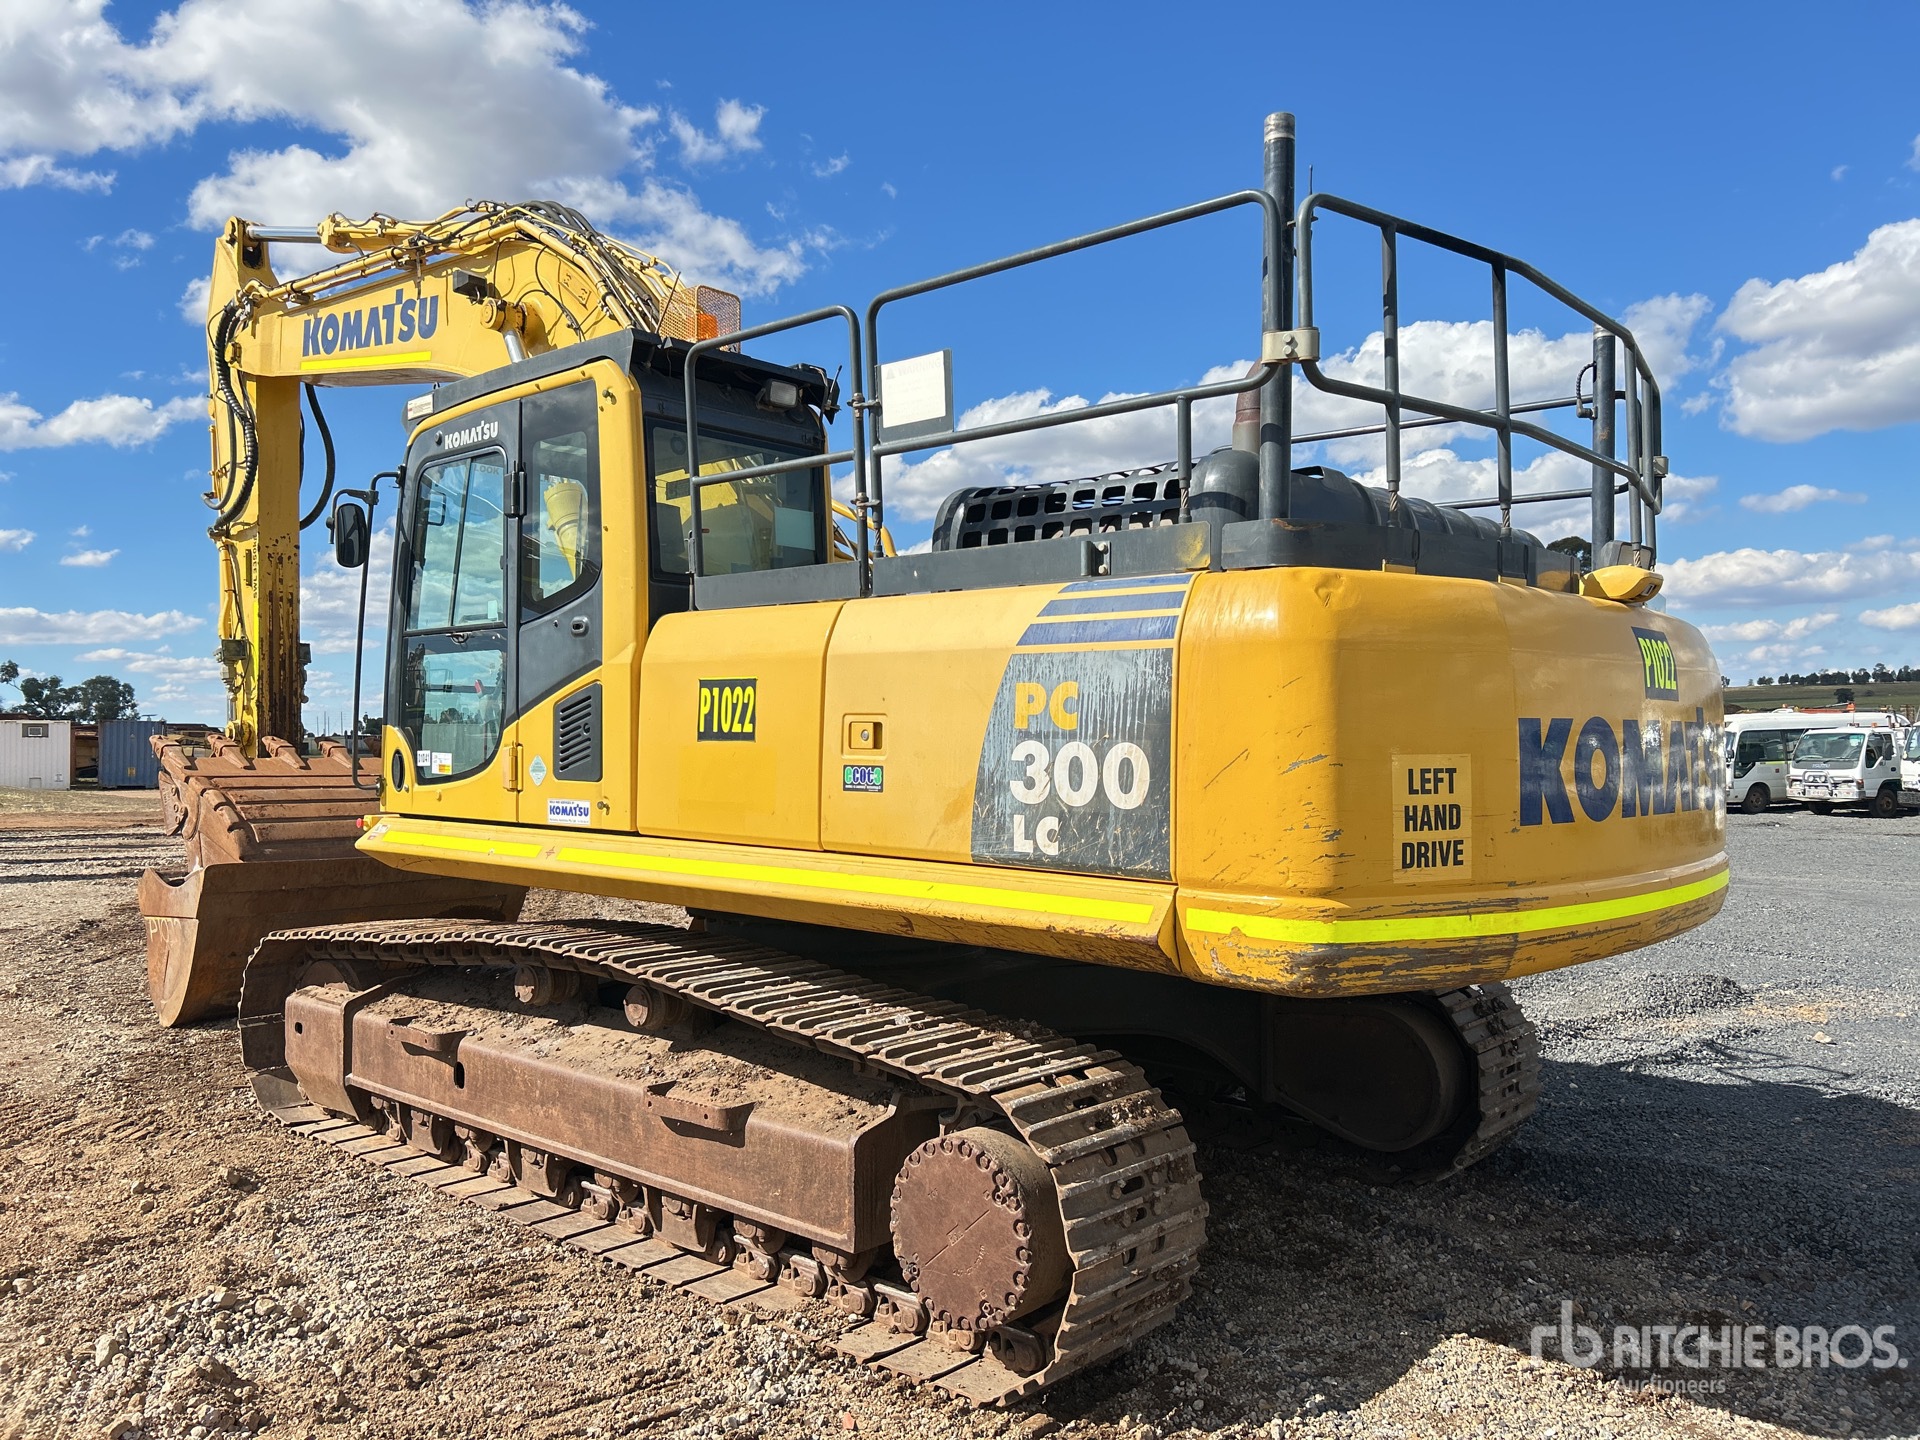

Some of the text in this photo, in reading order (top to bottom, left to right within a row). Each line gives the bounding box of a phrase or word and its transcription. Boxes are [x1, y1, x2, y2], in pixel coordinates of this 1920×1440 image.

[302, 288, 439, 357] KOMATSU
[444, 420, 499, 450] KOMATSU
[1637, 637, 1677, 690] P1022
[699, 686, 755, 733] P1022
[1013, 681, 1079, 731] PC
[1009, 740, 1150, 810] 300
[1408, 768, 1457, 795] LEFT
[549, 803, 589, 817] KOMATSU
[1404, 804, 1461, 832] HAND
[1013, 814, 1059, 856] LC
[1402, 840, 1464, 869] DRIVE
